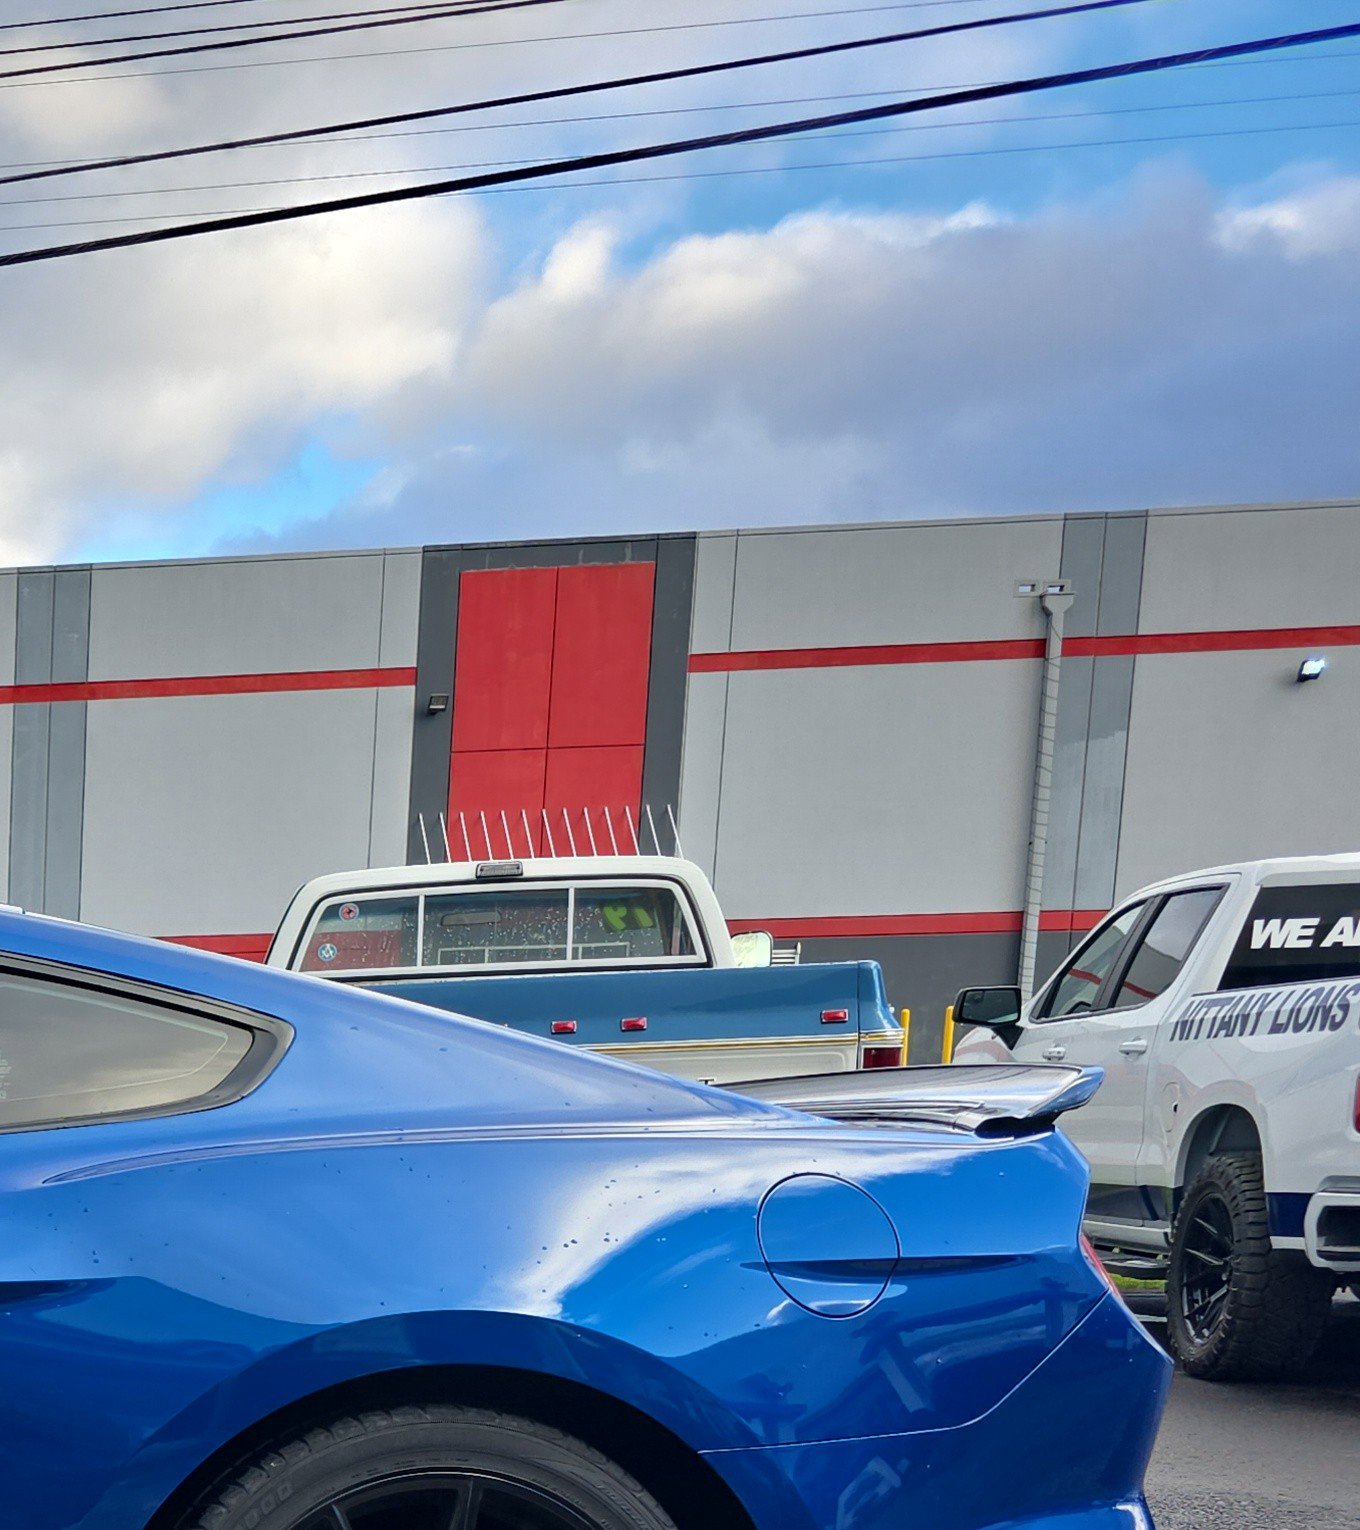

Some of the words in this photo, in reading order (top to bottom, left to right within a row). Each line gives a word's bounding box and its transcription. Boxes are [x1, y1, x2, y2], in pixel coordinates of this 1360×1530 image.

[1251, 918, 1320, 949] WE
[1320, 916, 1360, 948] A
[1169, 991, 1282, 1042] NITTANY
[1267, 983, 1360, 1035] LIONS
